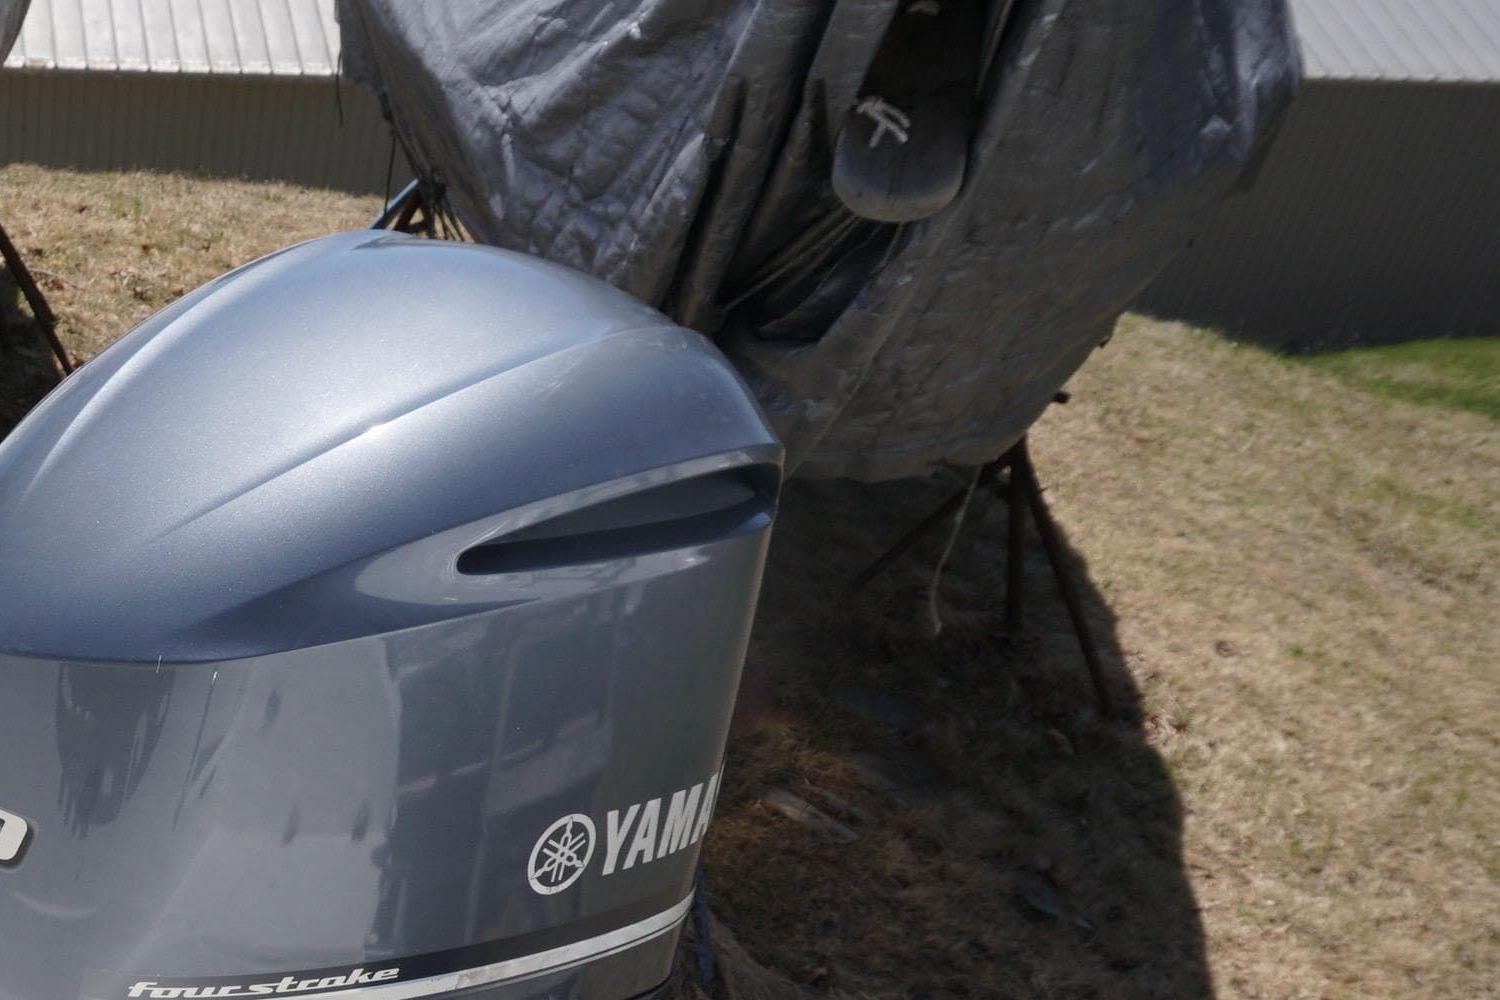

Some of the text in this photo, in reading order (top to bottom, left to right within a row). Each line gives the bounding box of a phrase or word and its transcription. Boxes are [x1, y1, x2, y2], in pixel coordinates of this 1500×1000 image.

[601, 768, 721, 877] YAMA
[128, 967, 400, 999] four stroke
